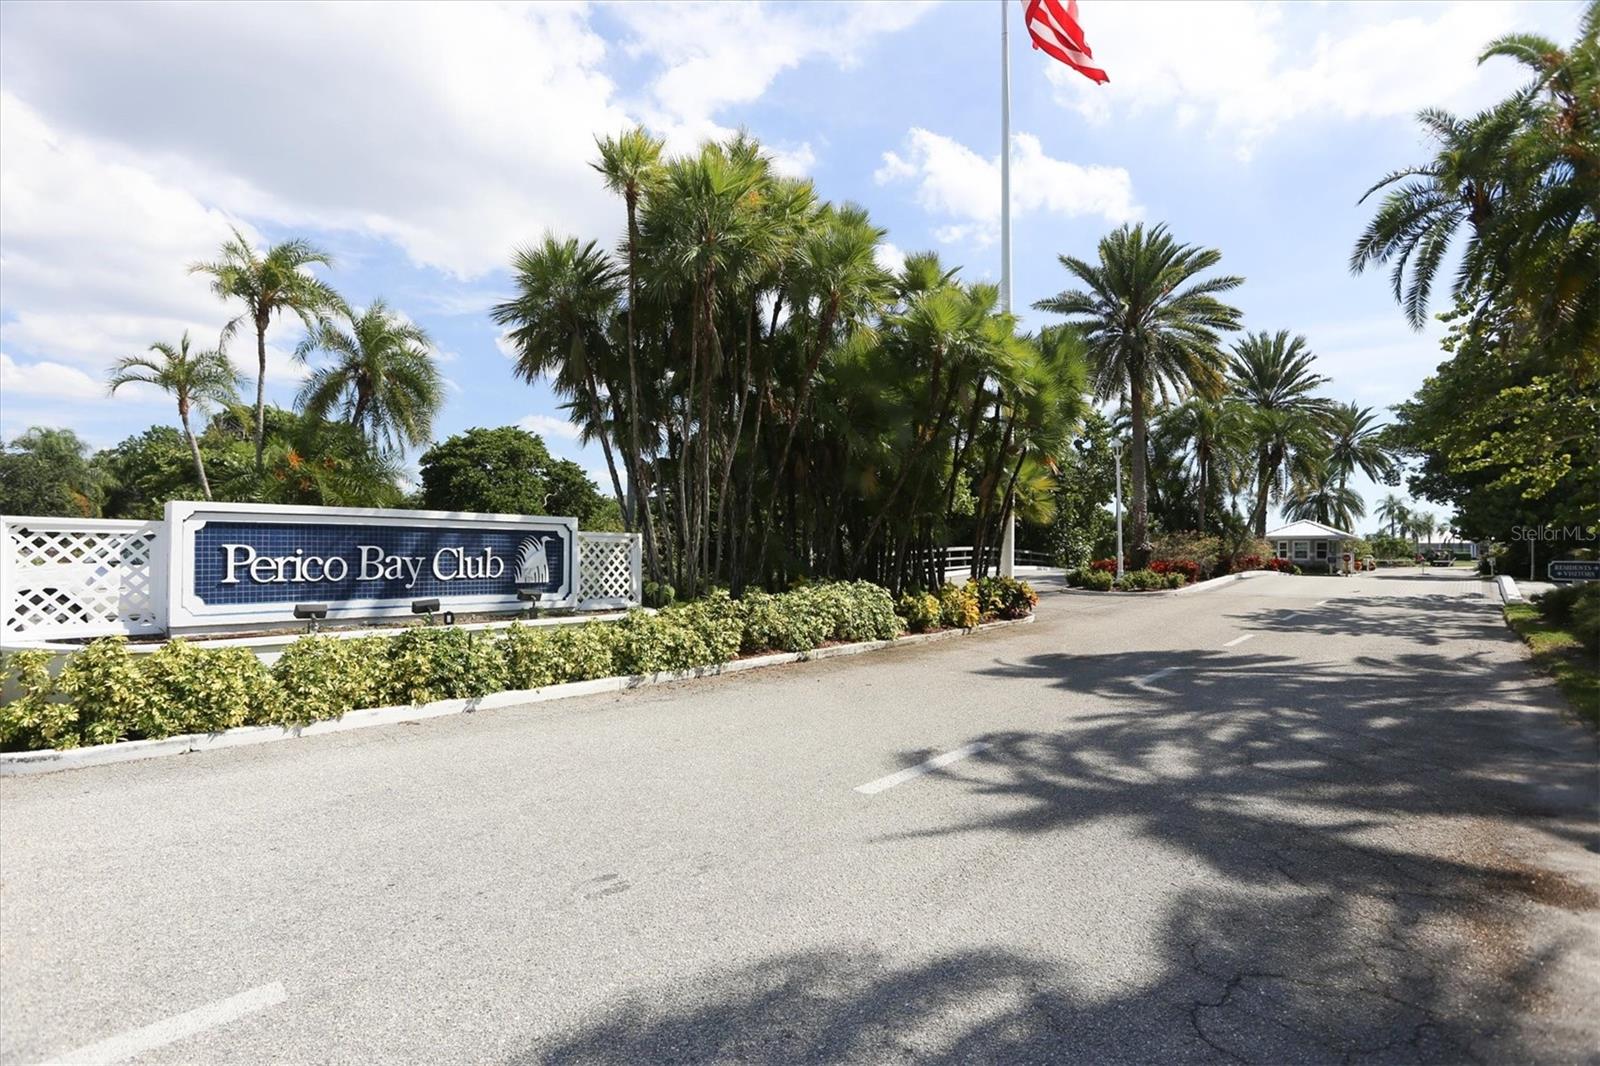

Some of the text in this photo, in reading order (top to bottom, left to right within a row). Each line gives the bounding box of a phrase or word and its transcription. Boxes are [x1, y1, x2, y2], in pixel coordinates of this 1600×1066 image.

[221, 543, 505, 589] Perico Bay Club
